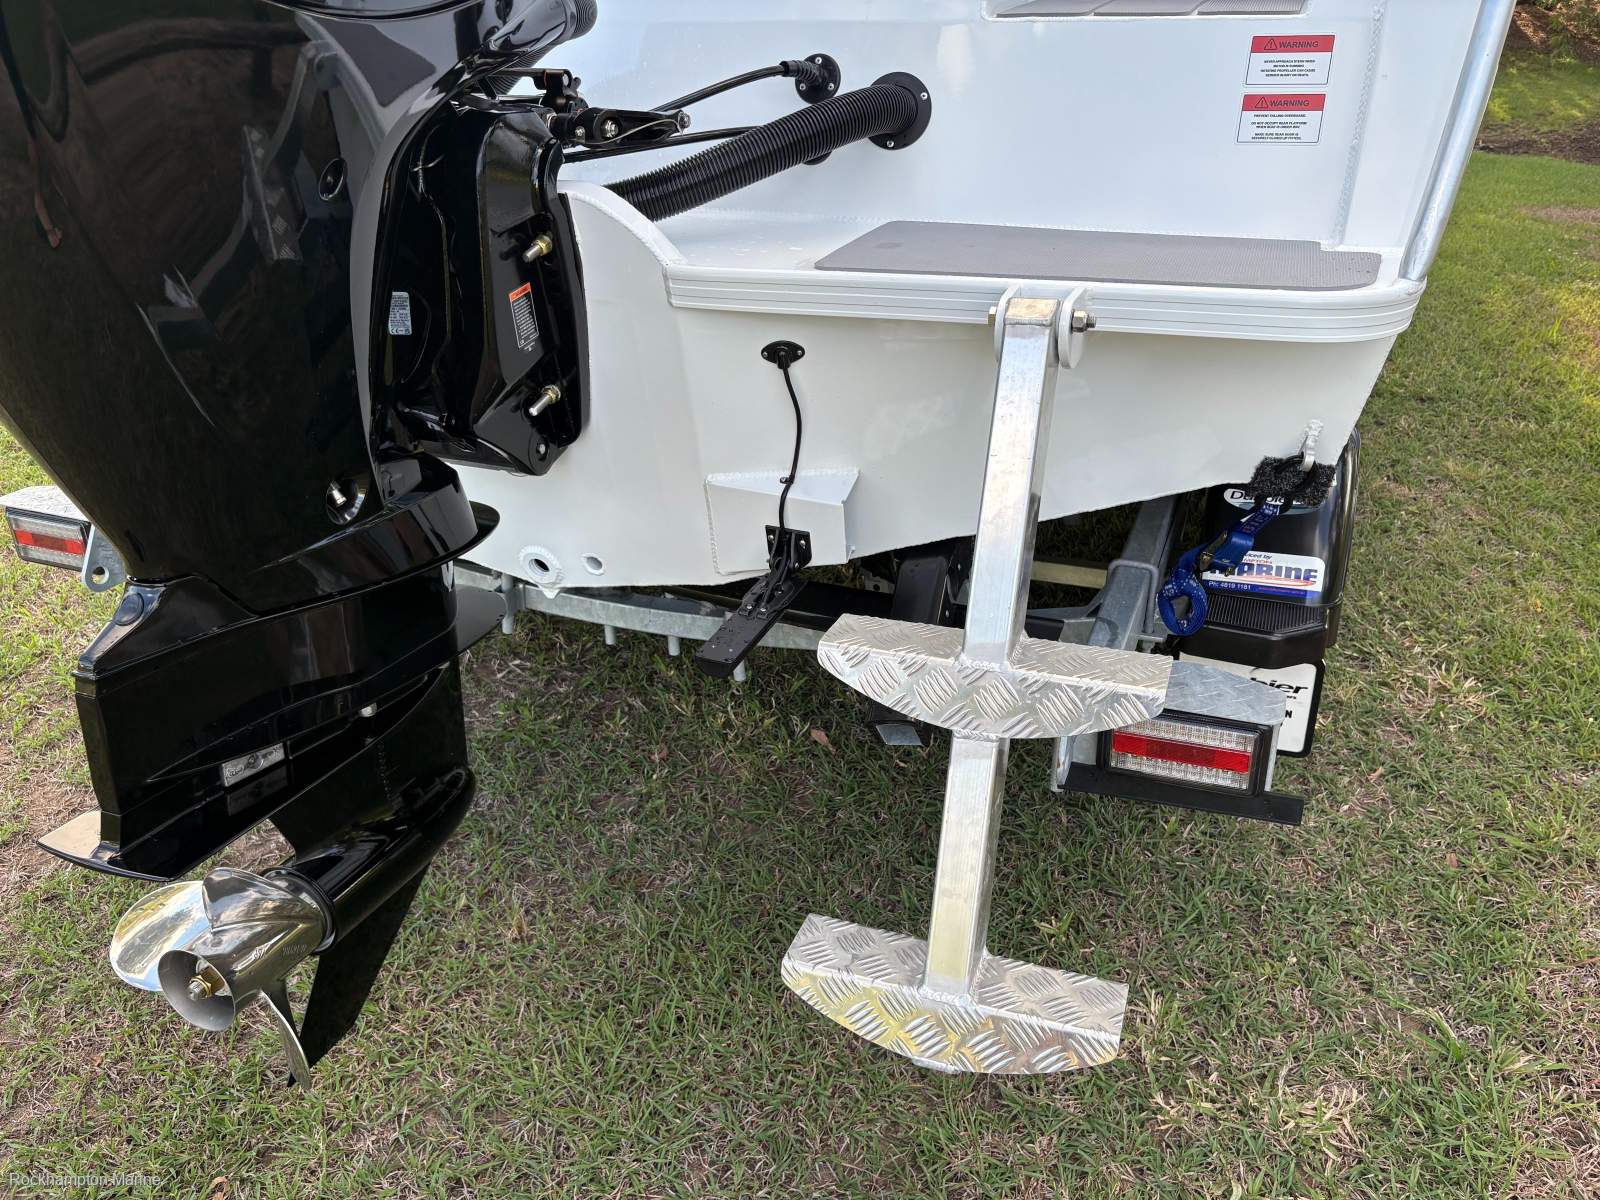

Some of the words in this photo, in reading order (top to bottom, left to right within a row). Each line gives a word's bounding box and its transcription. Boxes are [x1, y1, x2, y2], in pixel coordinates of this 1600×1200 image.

[1279, 40, 1319, 49] WARNING
[1270, 99, 1309, 107] WARNING
[1209, 562, 1318, 584] ARINE
[1221, 581, 1235, 589] 4819
